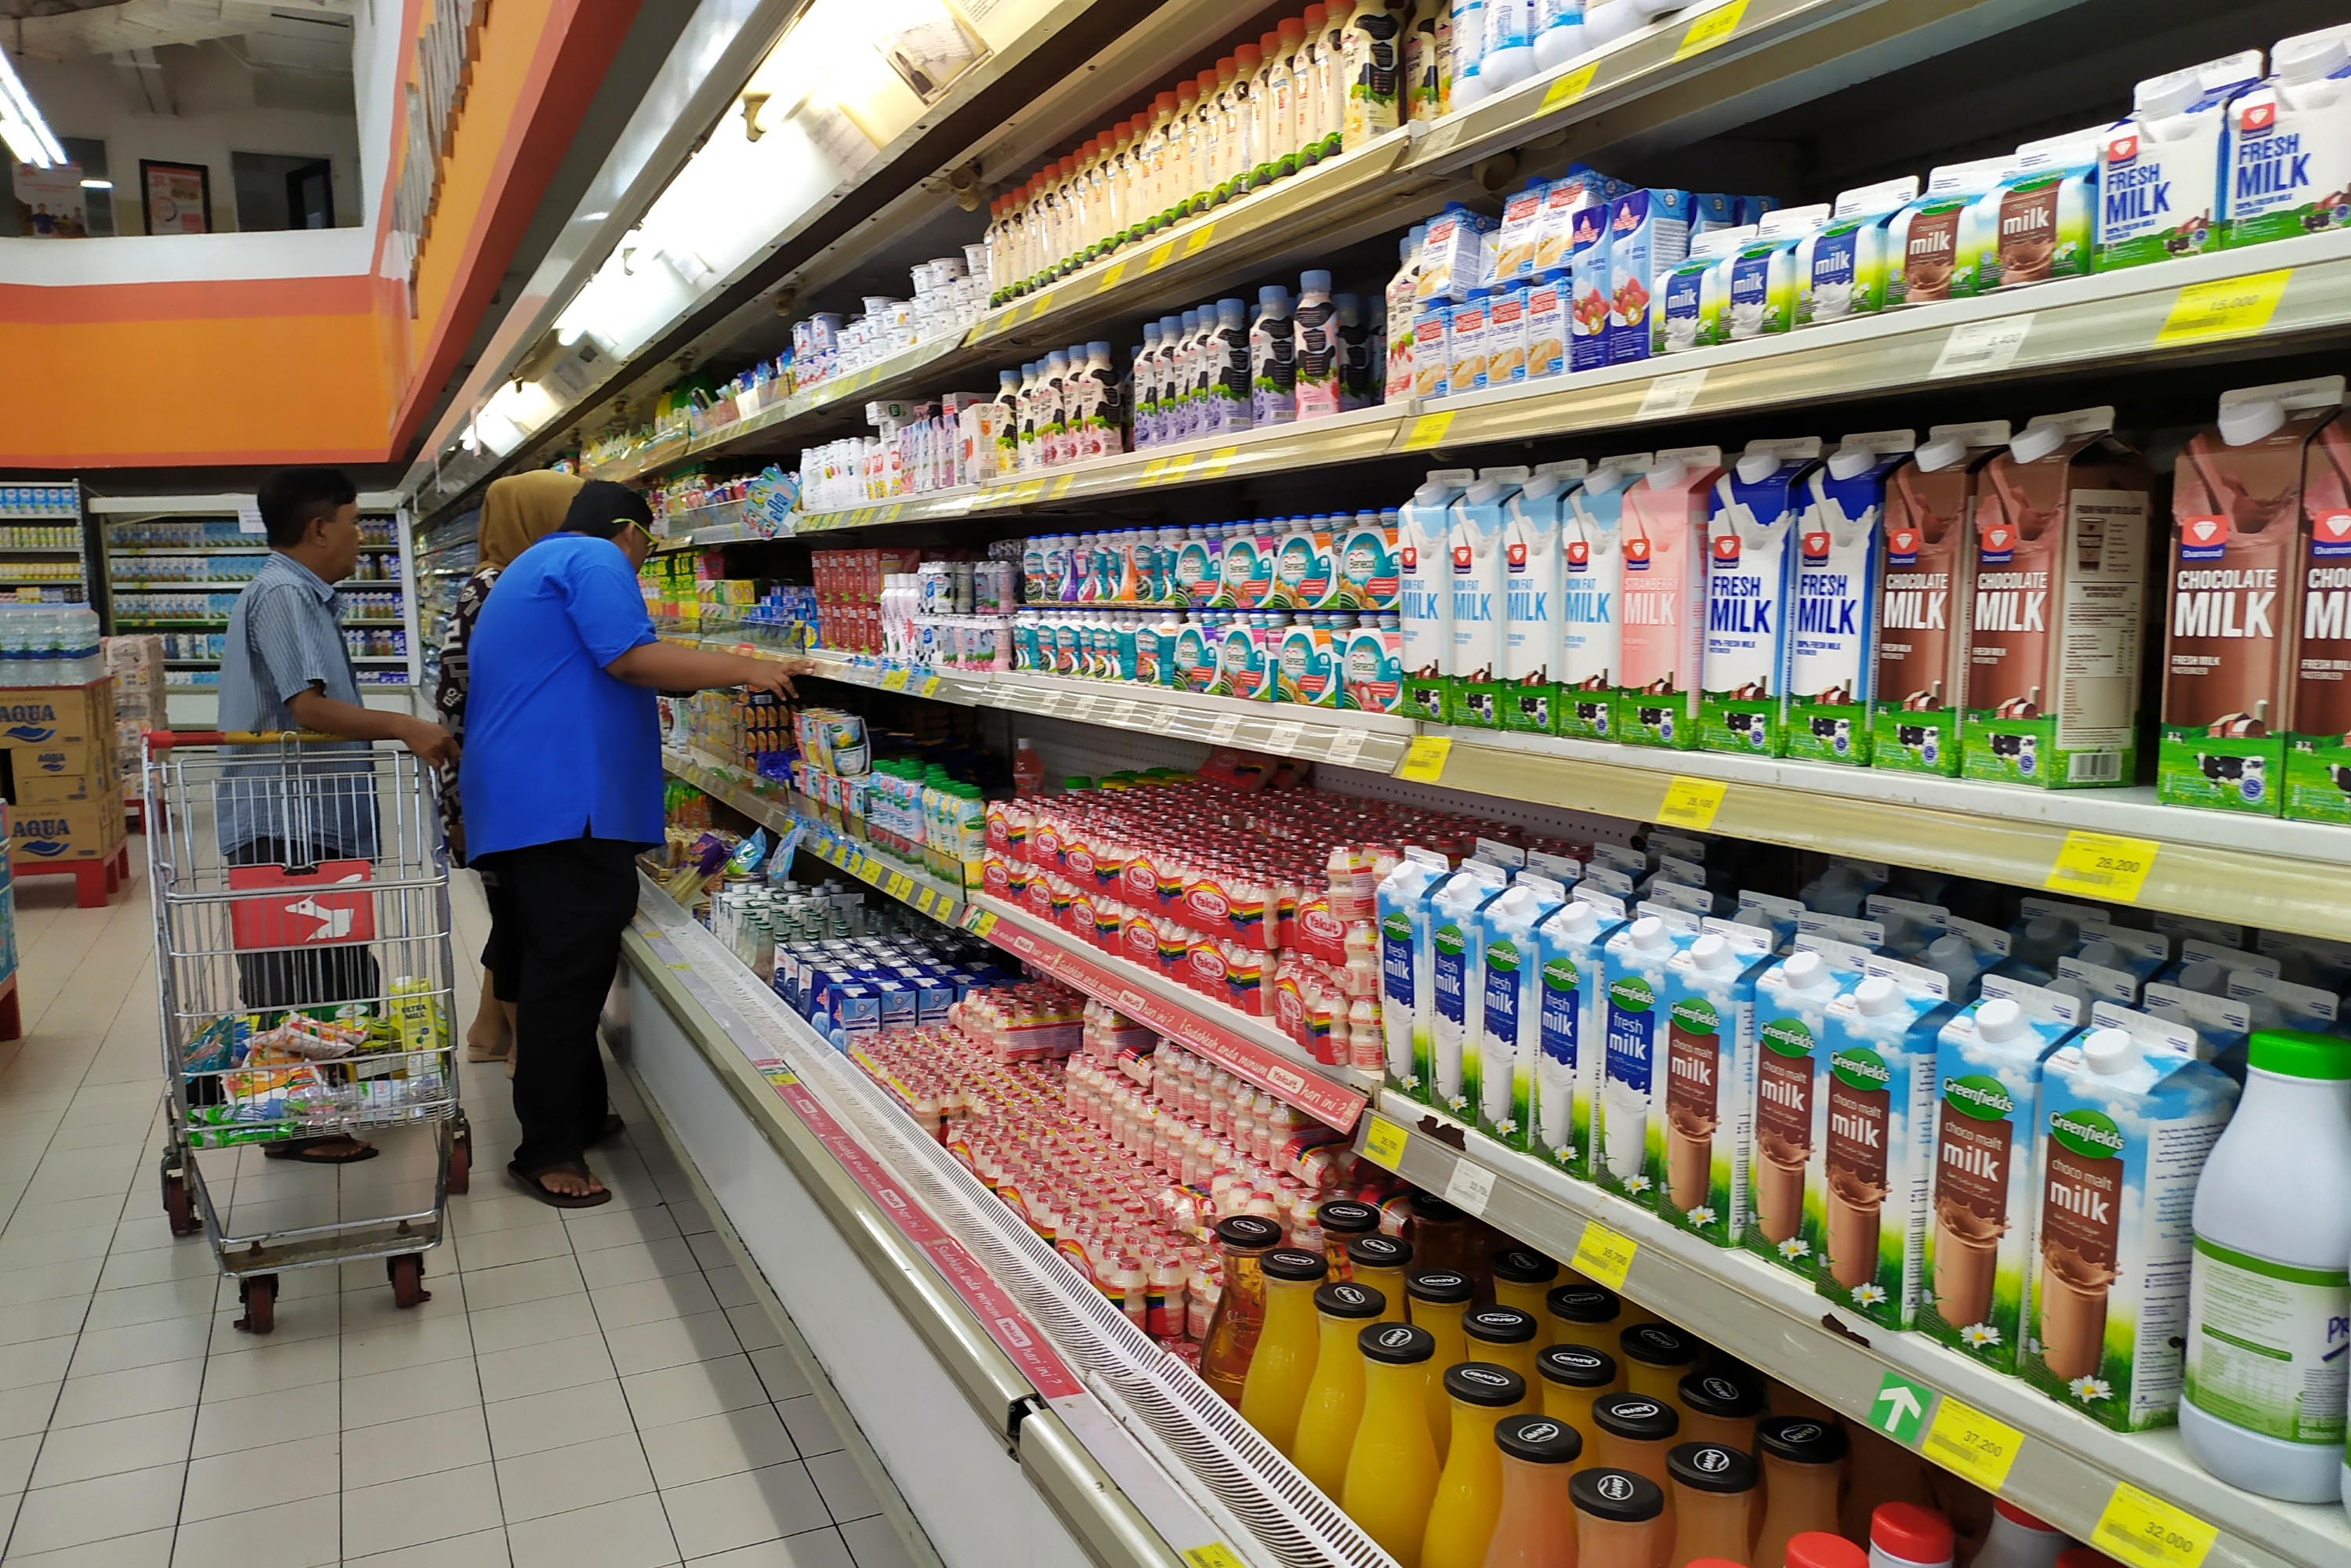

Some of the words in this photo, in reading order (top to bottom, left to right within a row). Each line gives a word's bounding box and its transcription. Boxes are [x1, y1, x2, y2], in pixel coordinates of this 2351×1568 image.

[2239, 131, 2300, 165] FRESH
[2106, 163, 2161, 194] FRESH
[2236, 153, 2311, 199] MILK
[2106, 181, 2171, 226] MILK
[2003, 206, 2050, 235] milk
[1909, 230, 1951, 255] milk
[1815, 251, 1851, 275] milk
[1733, 272, 1764, 294] milk
[1668, 288, 1698, 309] milk
[1712, 576, 1761, 596] FRESH
[1801, 574, 1847, 596] FRESH
[1886, 574, 1948, 589] CHOCOLATE
[1977, 571, 2048, 589] CHOCOLATE
[2177, 569, 2277, 589] CHOCOLATE
[1402, 592, 1438, 619] MILK
[1454, 592, 1491, 621] MILK
[1507, 592, 1547, 621] MILK
[1565, 592, 1610, 623] MILK
[1624, 592, 1676, 625] MILK
[1710, 599, 1771, 633] MILK
[1799, 598, 1857, 634] MILK
[1883, 592, 1947, 629] MILK
[1974, 592, 2047, 632] MILK
[2174, 592, 2277, 638] MILK
[0, 704, 56, 724] AQUA
[13, 819, 71, 838] AQUA
[1195, 893, 1223, 913] Yakult
[1310, 914, 1339, 935] Yakult
[1386, 941, 1407, 960] fresh
[1486, 943, 1520, 965] Greenfields
[1196, 954, 1221, 975] Yakult
[1385, 958, 1411, 980] milk
[1437, 955, 1458, 975] fresh
[1542, 961, 1580, 984] Greenfields
[1436, 973, 1461, 997] milk
[1489, 972, 1512, 993] fresh
[1608, 980, 1656, 1005] Greenfields
[1486, 990, 1514, 1016] milk
[1545, 990, 1570, 1013] fresh
[1670, 1001, 1720, 1027] Greenfields
[404, 1010, 426, 1020] MILK
[1542, 1011, 1573, 1037] milk
[1613, 1012, 1643, 1035] fresh
[1609, 1032, 1647, 1060] milk
[1760, 1022, 1816, 1050] Greenfields
[1183, 1023, 1219, 1051] Sudahkah
[1217, 1044, 1239, 1061] anda
[1238, 1054, 1269, 1077] minum
[1272, 1070, 1299, 1090] Yakult
[1300, 1083, 1325, 1103] hari
[1322, 1093, 1341, 1110] ini
[1672, 1056, 1712, 1087] milk
[1762, 1060, 1785, 1077] choco
[1786, 1069, 1807, 1085] malt
[1830, 1052, 1891, 1083] Greenfields
[1762, 1078, 1806, 1112] milk
[1832, 1092, 1858, 1111] choco
[1859, 1103, 1882, 1120] malt
[1943, 1077, 2016, 1113] Greenfields
[1831, 1113, 1880, 1150] milk
[1944, 1121, 1973, 1142] choco
[1975, 1133, 2003, 1152] malt
[2049, 1111, 2125, 1150] Greenfields
[1943, 1142, 2000, 1183] milk
[2052, 1157, 2083, 1181] choco
[2084, 1172, 2113, 1192] malt
[1331, 1207, 1365, 1217] Juver
[2049, 1180, 2110, 1226] milk
[1235, 1220, 1266, 1233] Juver
[1365, 1239, 1395, 1252] Juver
[1339, 1287, 1361, 1303] Juver
[935, 1244, 966, 1276] Sudahkah
[960, 1273, 980, 1292] anda
[976, 1291, 1002, 1320] minum
[1001, 1320, 1025, 1345] Yakult
[1021, 1346, 1047, 1365] hari
[1034, 1360, 1058, 1379] ini
[1482, 1314, 1518, 1324] Juver
[1615, 1404, 1656, 1417] Juver
[1522, 1425, 1556, 1441] Juver
[1962, 1430, 2003, 1457] 37.200
[1703, 1450, 1719, 1471] Juver
[1607, 1477, 1624, 1498] Juver
[2144, 1522, 2193, 1553] 32.000
